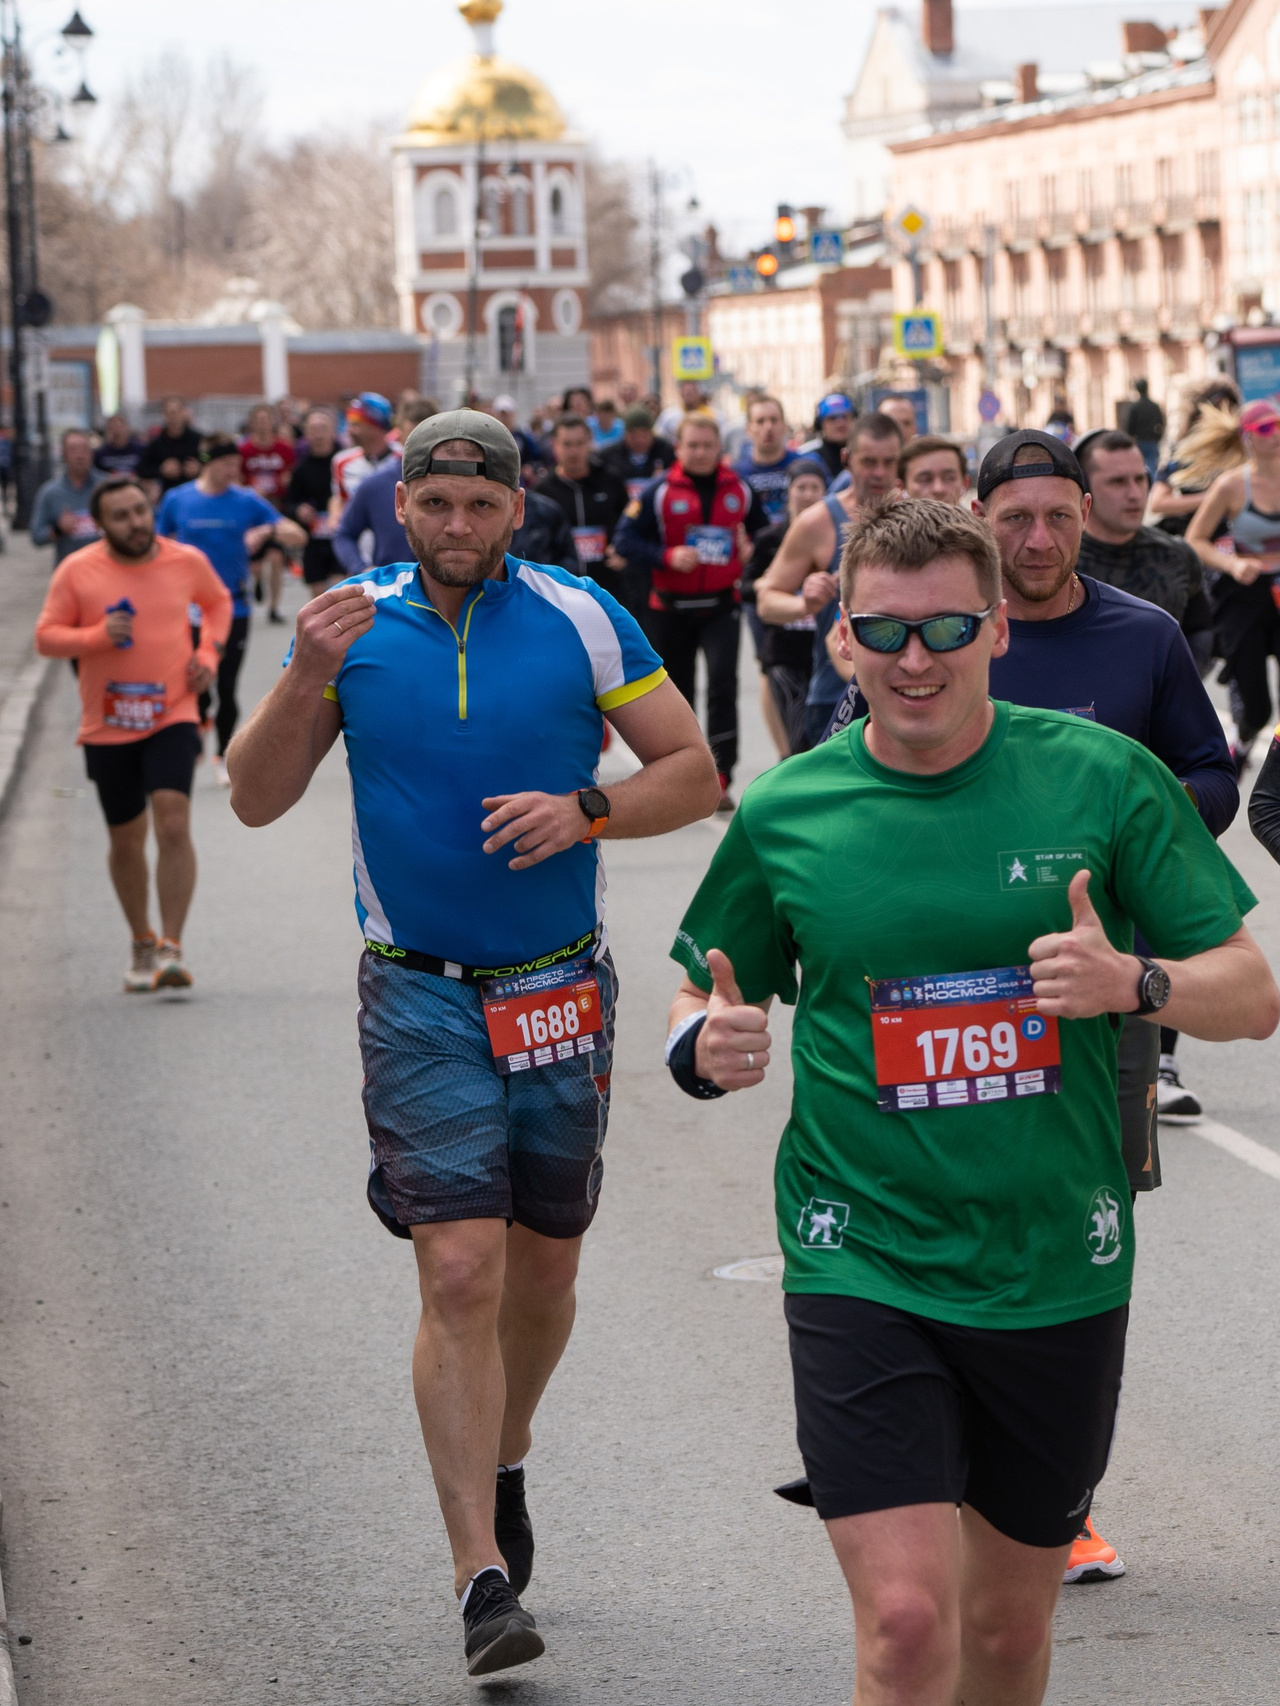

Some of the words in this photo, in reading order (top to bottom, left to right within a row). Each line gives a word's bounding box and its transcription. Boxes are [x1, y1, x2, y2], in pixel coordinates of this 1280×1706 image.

[472, 933, 592, 978] POWERUP
[520, 975, 565, 992] КОСМОС
[526, 969, 565, 983] ПРОСТО
[924, 983, 935, 992] Я
[936, 976, 997, 990] ПРОСТО
[924, 985, 998, 1001] КОСМОС
[580, 997, 590, 1010] E
[516, 1000, 580, 1047] 1688
[879, 1016, 890, 1025] 10
[1027, 1020, 1042, 1035] D
[916, 1021, 1018, 1077] 1769
